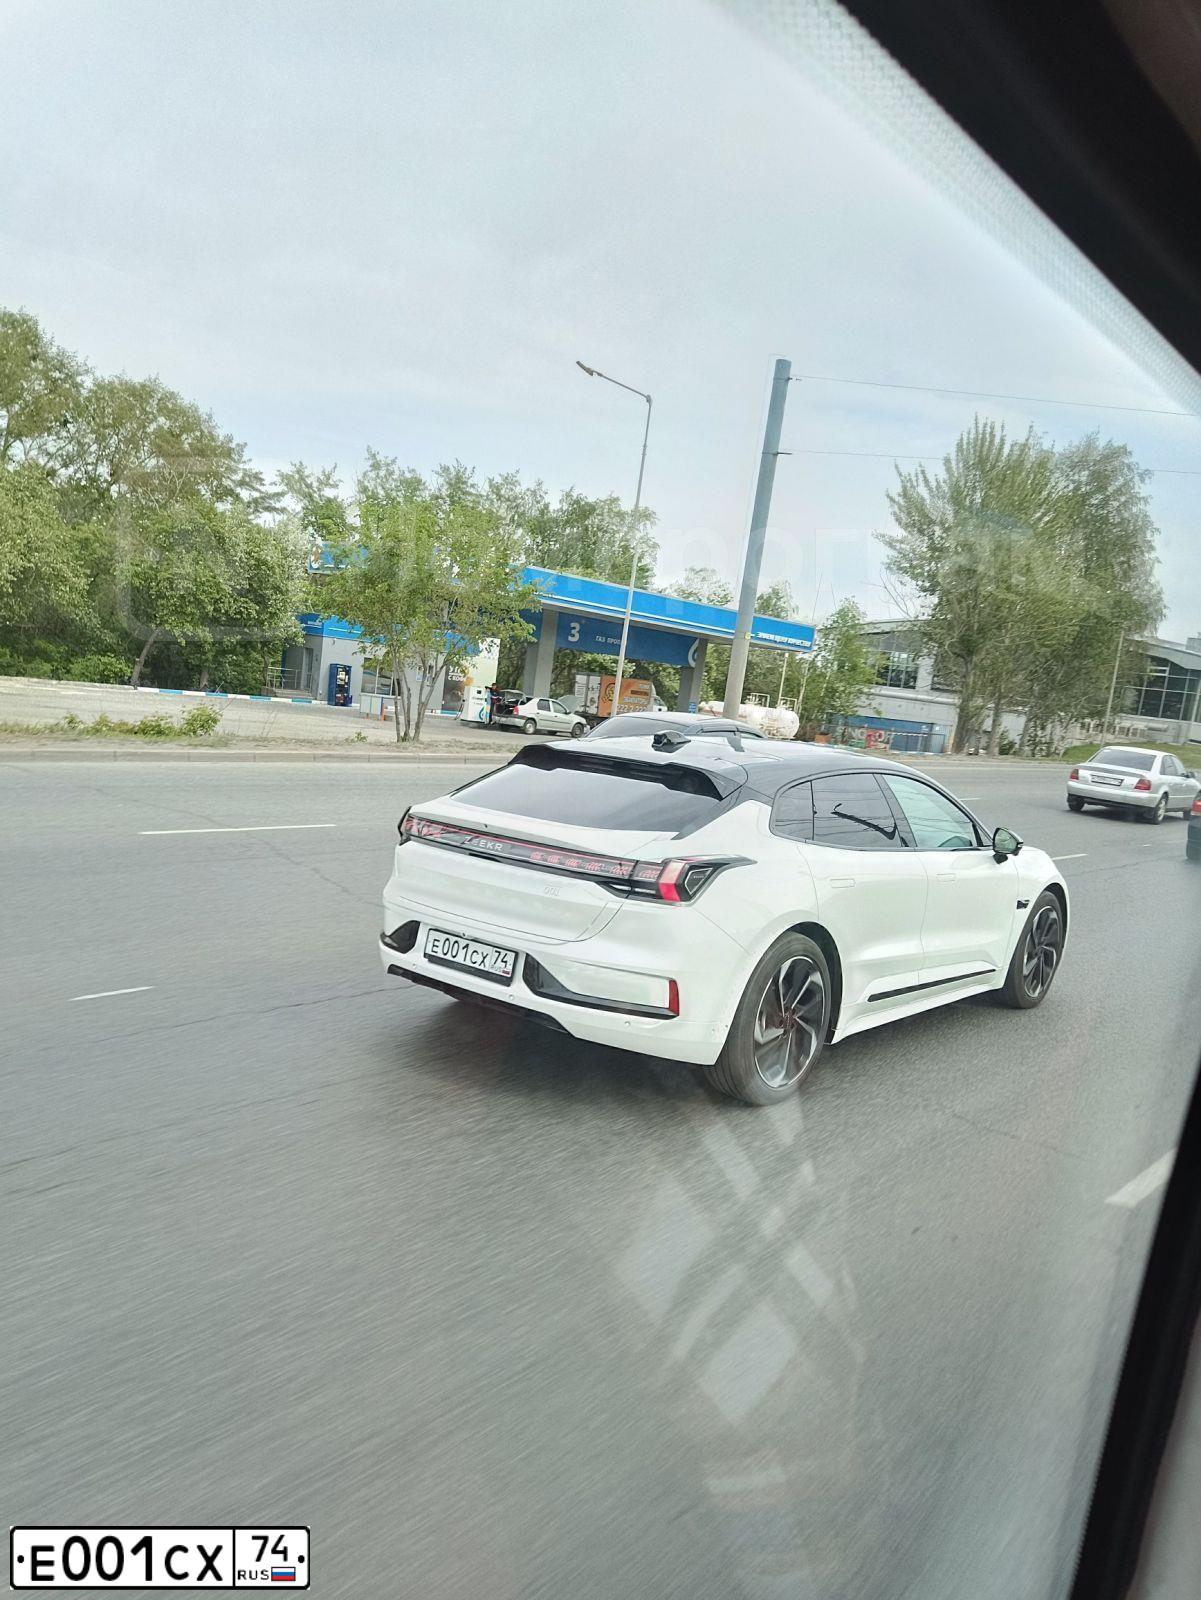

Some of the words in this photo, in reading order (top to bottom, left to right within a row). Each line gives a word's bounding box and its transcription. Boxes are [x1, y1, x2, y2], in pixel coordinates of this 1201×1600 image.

[567, 622, 581, 643] 3
[463, 836, 504, 852] ZEEKR
[493, 949, 509, 969] 74
